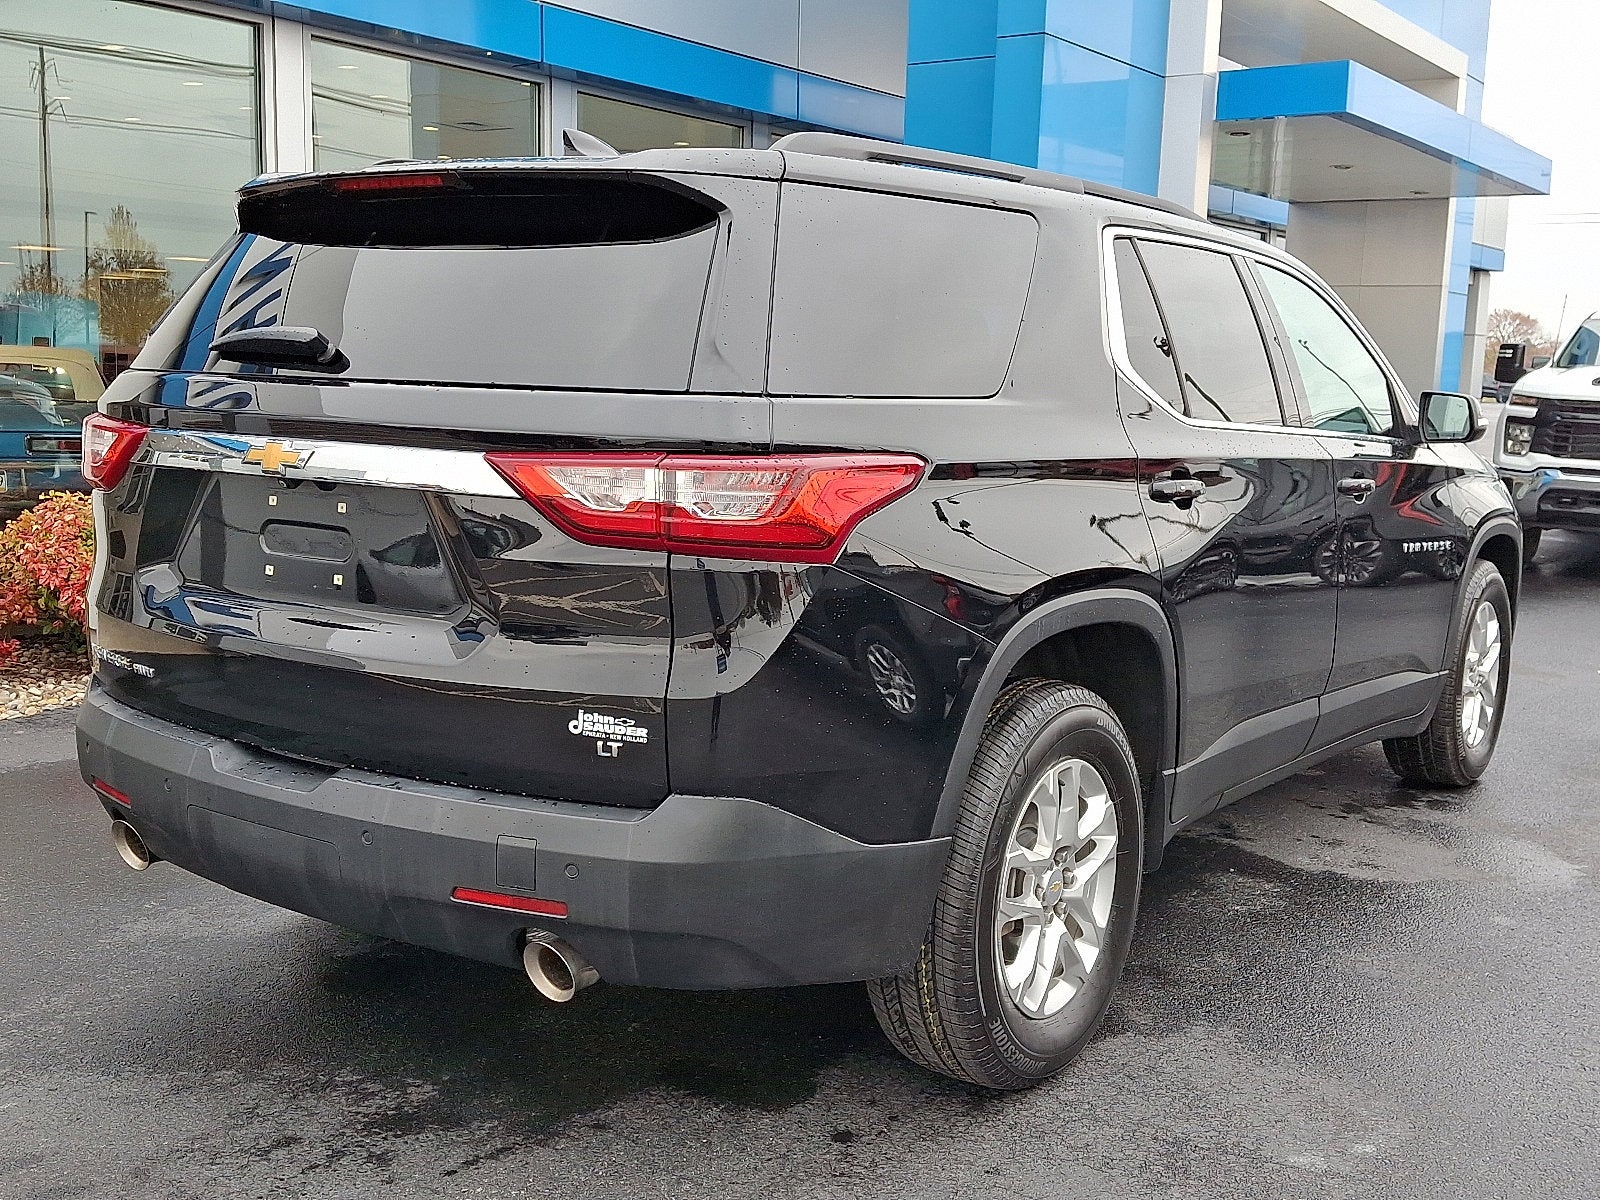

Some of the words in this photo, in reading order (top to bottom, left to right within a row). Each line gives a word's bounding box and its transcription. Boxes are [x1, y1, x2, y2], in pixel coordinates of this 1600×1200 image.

[583, 721, 648, 737] SAUDER
[609, 733, 622, 741] NEW
[622, 735, 648, 744] HOLLAND
[596, 740, 623, 757] LT
